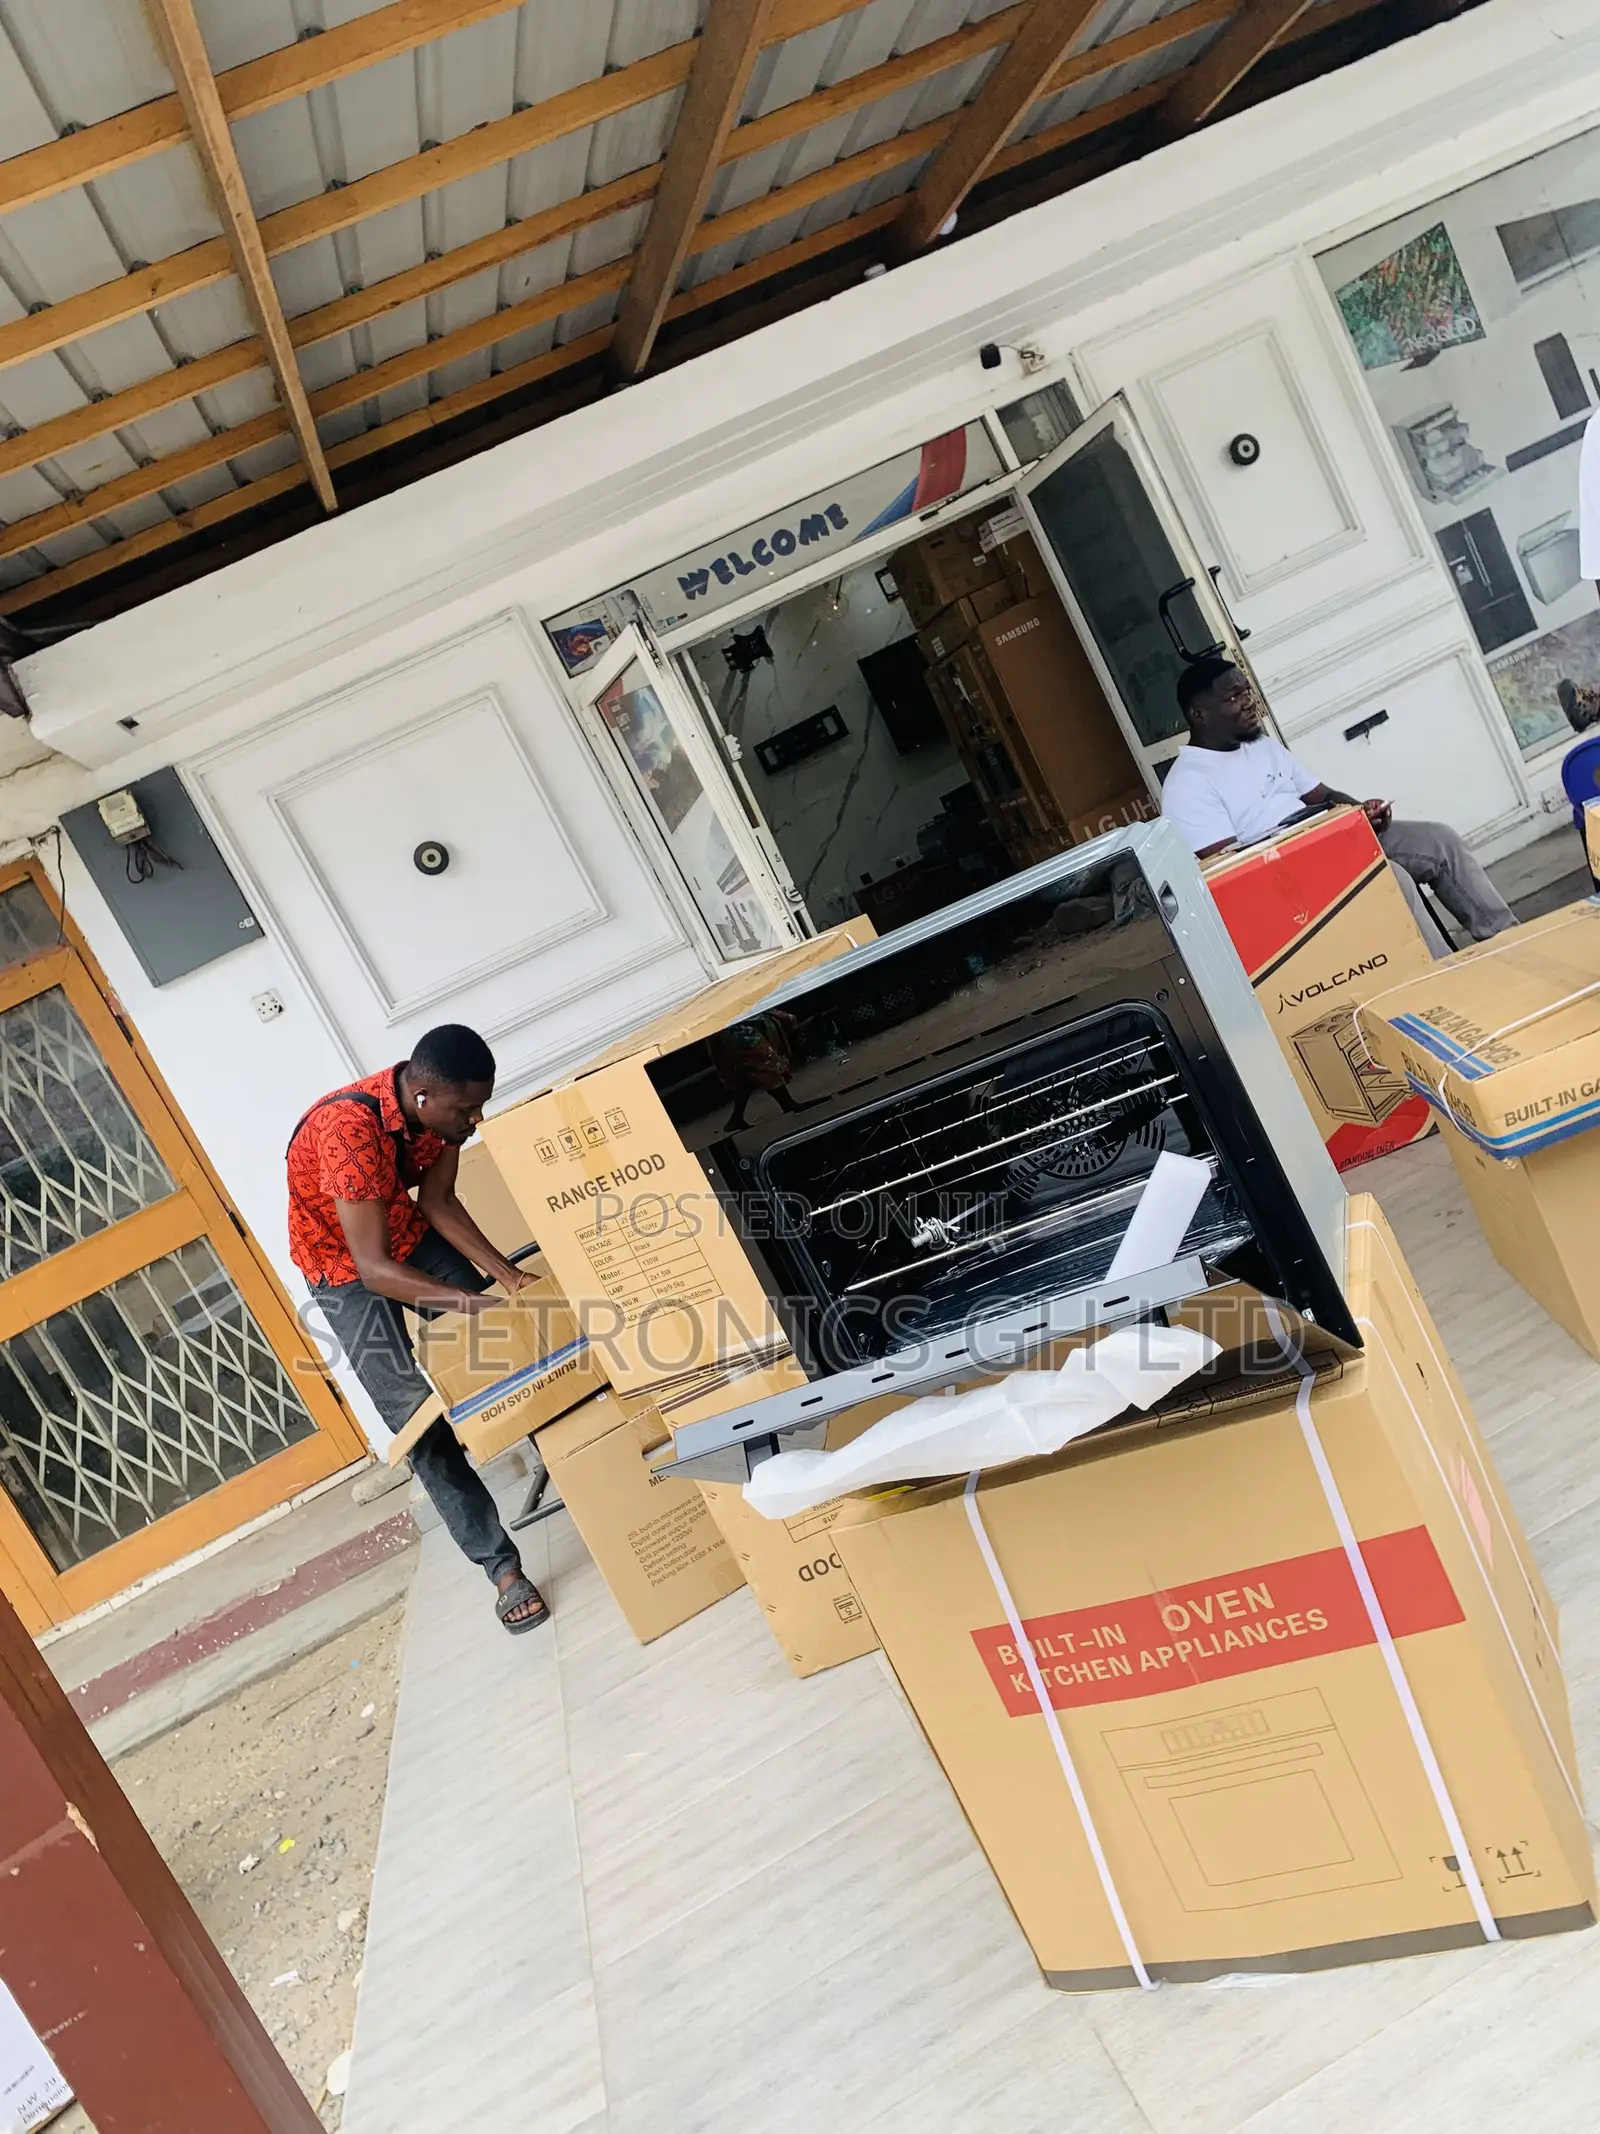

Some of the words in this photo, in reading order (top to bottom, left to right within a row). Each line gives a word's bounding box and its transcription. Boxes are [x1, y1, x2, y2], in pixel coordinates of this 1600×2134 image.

[677, 503, 849, 600] WELCOME
[994, 617, 1041, 646] SAMSUNG
[1291, 953, 1388, 1003] VOLCANO
[1503, 1087, 1577, 1128] BUILT-IN
[546, 1175, 611, 1212] RANGE
[611, 1153, 665, 1187] HOOD
[634, 1242, 651, 1252] Black
[642, 1256, 659, 1267] 130W
[531, 1359, 577, 1394] BUILT-IN
[507, 1387, 532, 1408] GAS
[480, 1402, 507, 1423] HOB
[648, 1475, 671, 1488] ME
[660, 1498, 692, 1521] microwave
[630, 1535, 651, 1549] Digital
[673, 1505, 698, 1523] cooking
[634, 1535, 668, 1556] Microwave
[639, 1553, 653, 1564] Grill
[652, 1542, 672, 1559] power
[643, 1557, 666, 1572] Defrost
[666, 1542, 687, 1559] setting
[647, 1566, 664, 1579] Push
[664, 1555, 684, 1569] button
[683, 1545, 698, 1557] door
[651, 1569, 677, 1587] Packing
[1161, 1582, 1276, 1633] OVEN
[1009, 1655, 1134, 1694] KTCHEN
[1139, 1608, 1330, 1673] APPLIANCES
